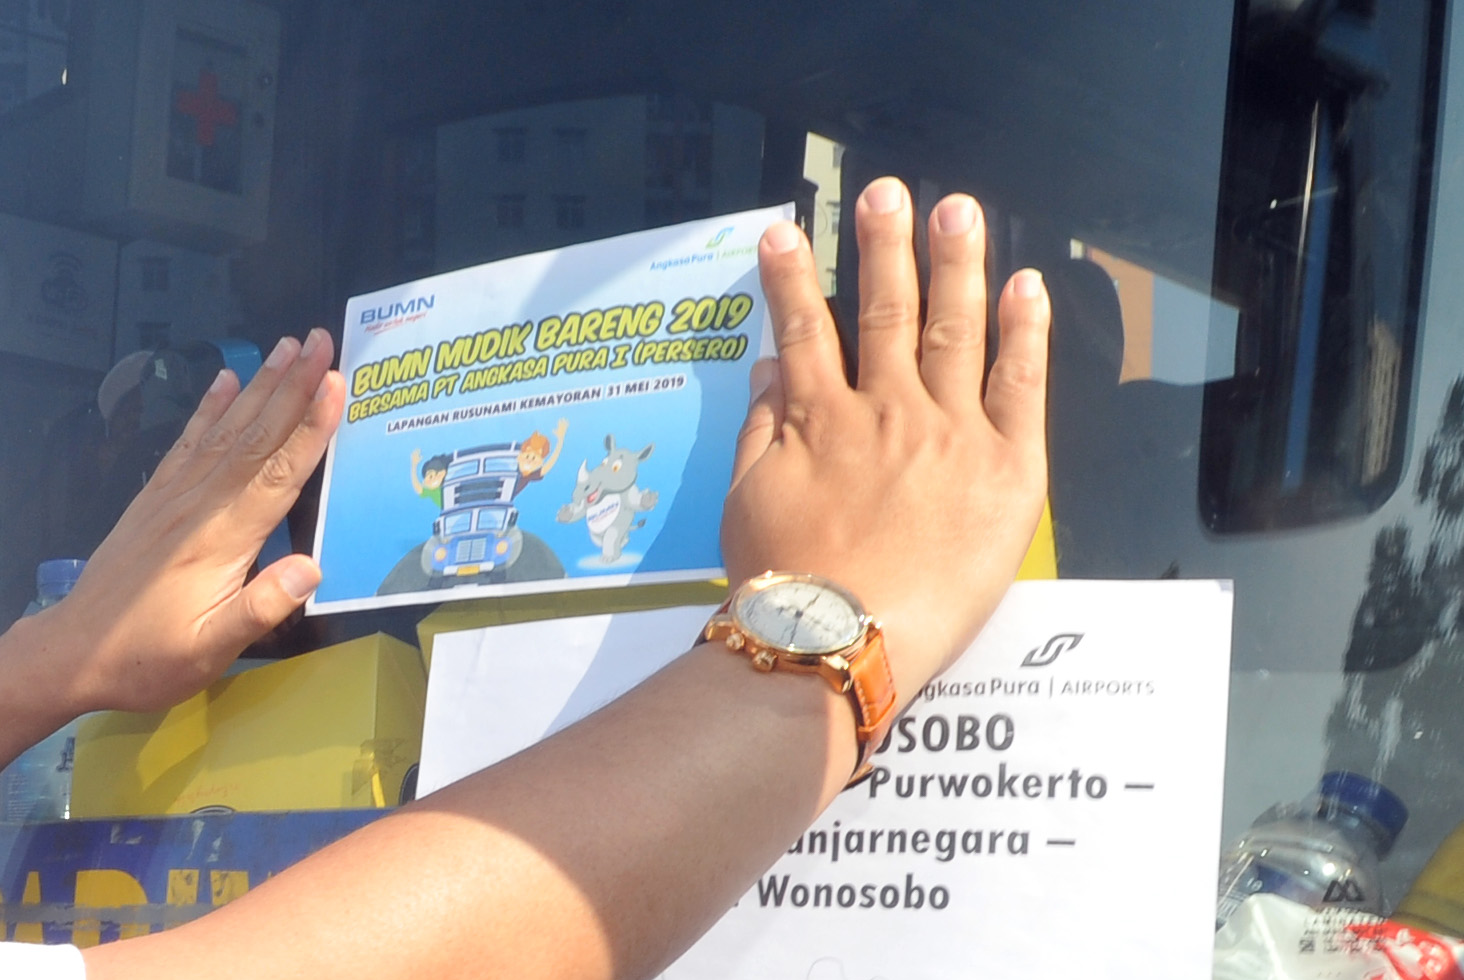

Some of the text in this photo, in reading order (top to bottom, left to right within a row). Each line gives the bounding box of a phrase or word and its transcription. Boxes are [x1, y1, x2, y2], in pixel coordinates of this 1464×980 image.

[360, 294, 435, 324] BUMN
[352, 293, 753, 396] BUMN MUDIK BARENG 2019
[348, 334, 748, 423] BERSAMA PT ANGKASA PURA I (PERSERO)
[387, 376, 685, 432] LAPANGAN RUSUNAMI KEMAYORAN 31 MEI 2019
[917, 678, 1155, 701] gkasa Pura AIRPORTS
[874, 713, 1015, 754] SOBO
[869, 762, 1108, 799] Purwokerto
[757, 873, 950, 910] Wonosobo
